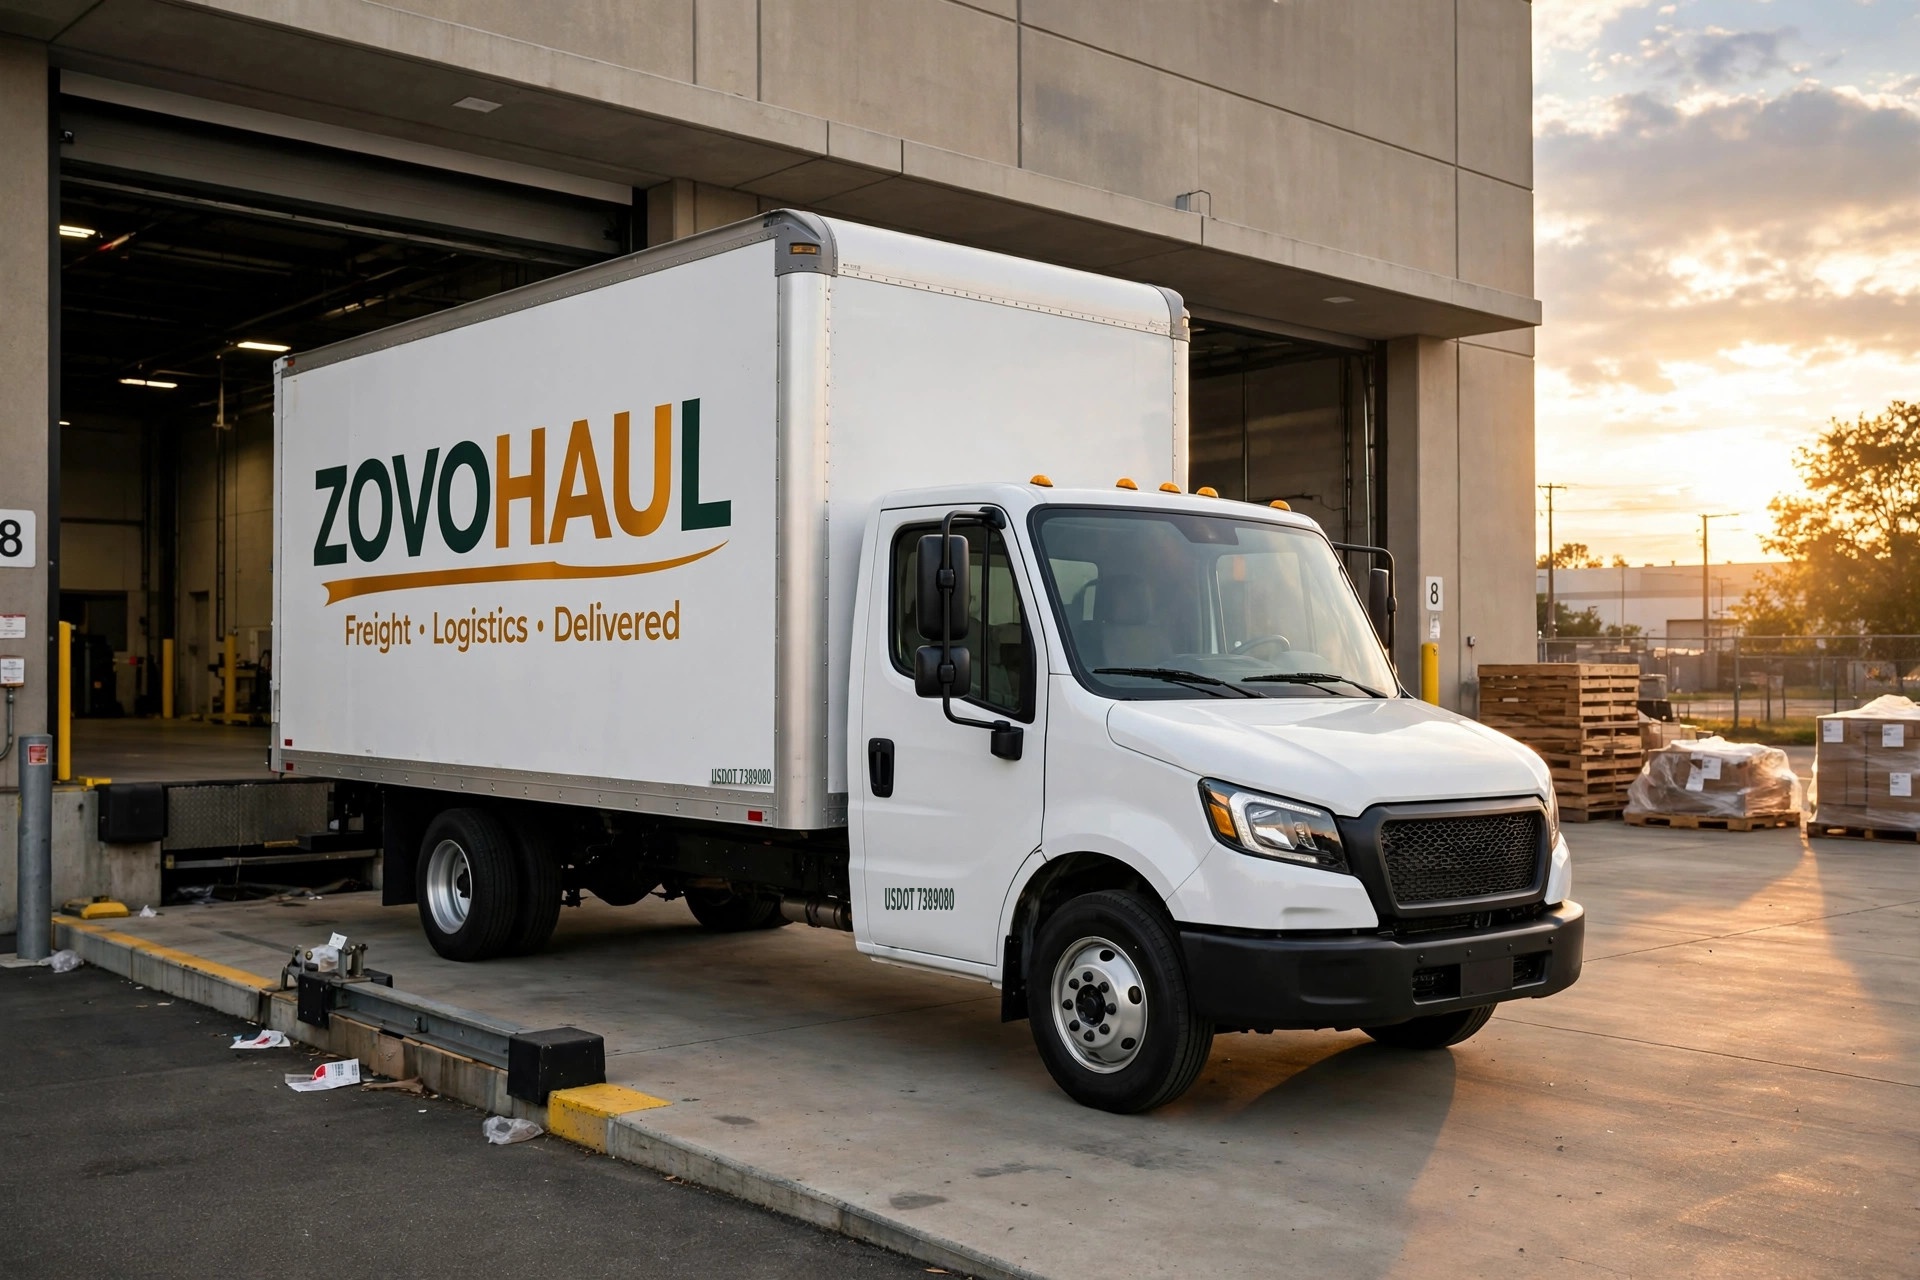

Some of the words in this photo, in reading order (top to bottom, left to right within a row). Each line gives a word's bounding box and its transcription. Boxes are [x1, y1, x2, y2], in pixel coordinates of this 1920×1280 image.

[314, 398, 731, 566] ZOVOHAUL
[0, 519, 23, 558] 8
[1430, 582, 1439, 605] 8
[345, 611, 411, 654] Freight
[433, 606, 528, 653] Logistics
[554, 600, 680, 642] Delivered
[711, 768, 737, 785] USDOT
[739, 768, 772, 785] 7389080
[884, 887, 915, 911] USDOT
[917, 887, 955, 911] 7389080
